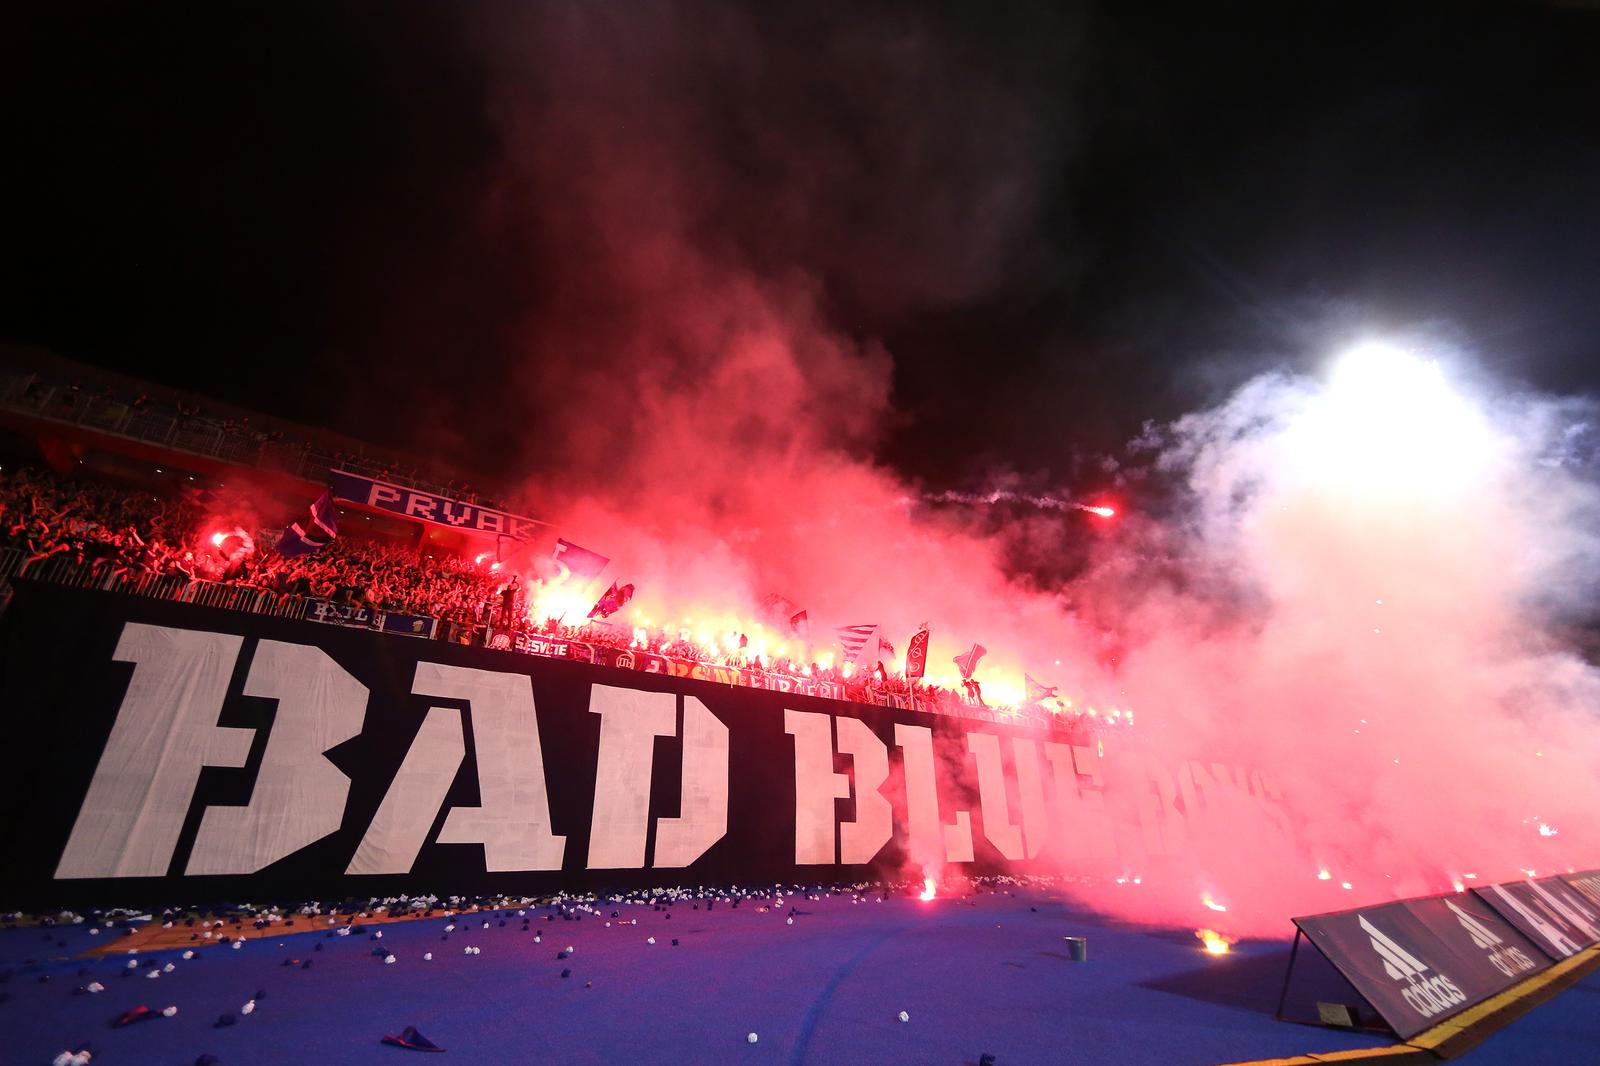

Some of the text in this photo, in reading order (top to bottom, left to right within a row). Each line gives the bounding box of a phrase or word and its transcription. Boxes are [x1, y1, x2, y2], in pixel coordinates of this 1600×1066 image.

[53, 622, 730, 879] BAD
[784, 708, 1117, 865] BLUE
[1401, 972, 1467, 1018] adidas
